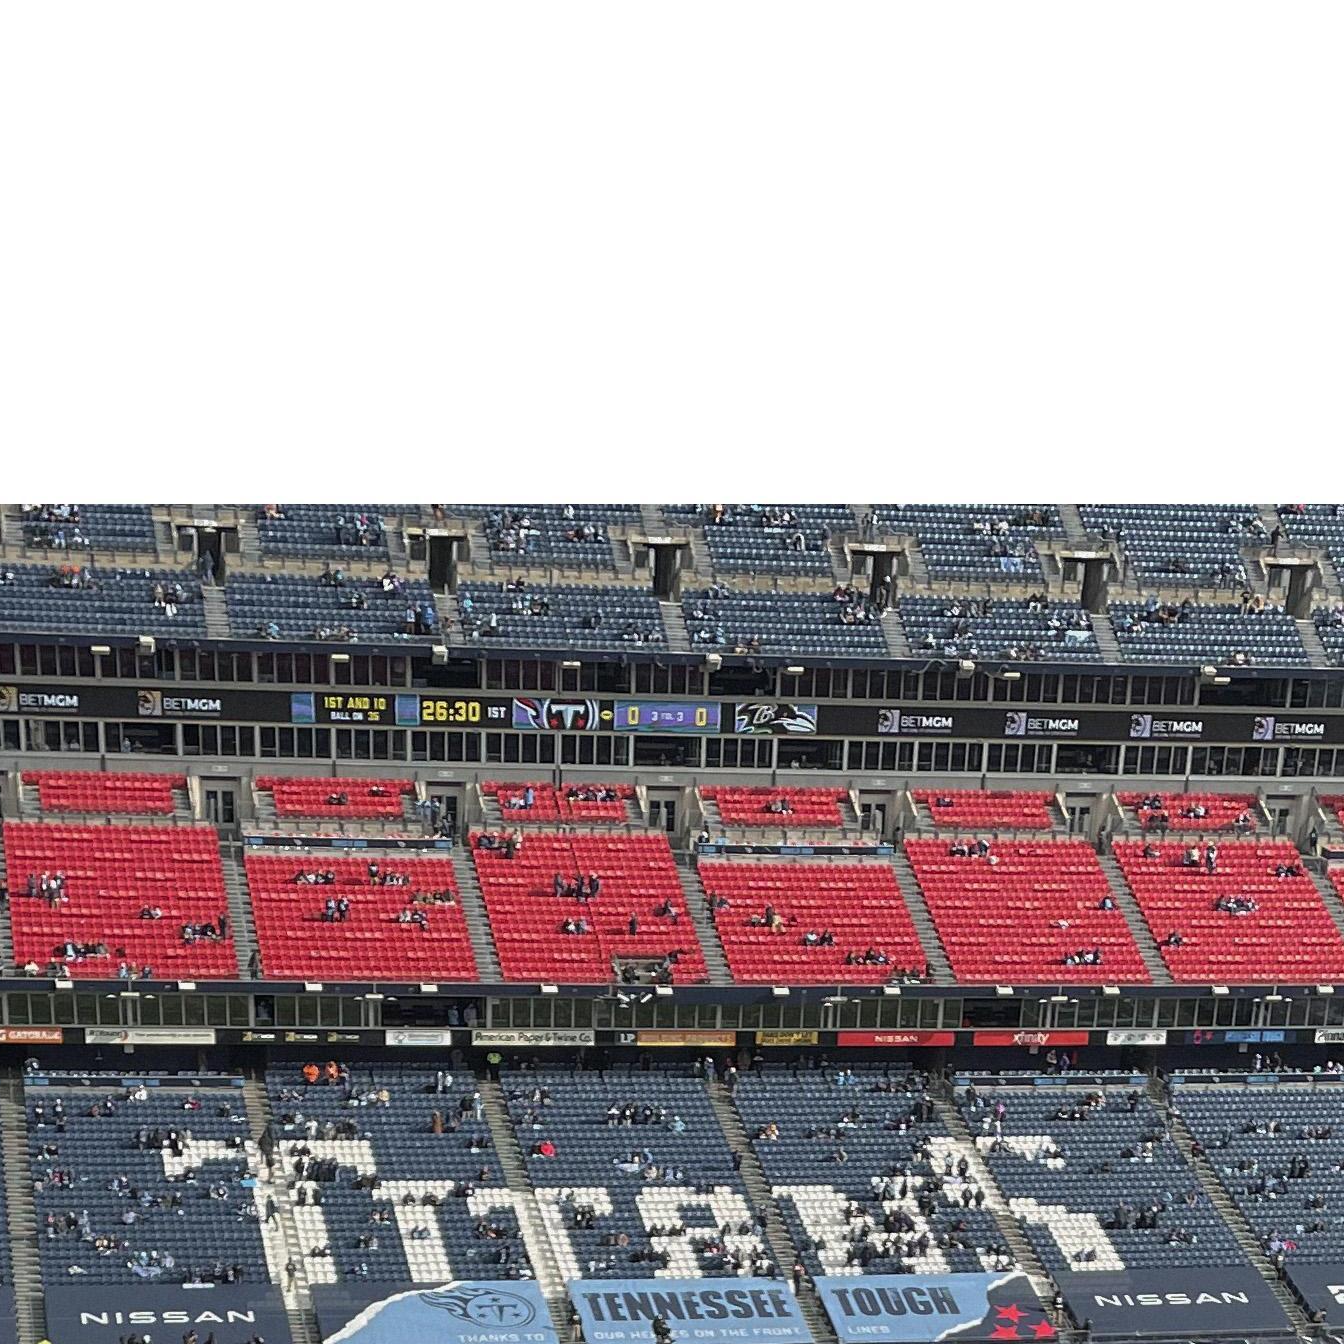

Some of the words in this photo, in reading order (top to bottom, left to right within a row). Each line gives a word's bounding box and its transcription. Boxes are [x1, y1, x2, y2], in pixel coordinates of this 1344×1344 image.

[19, 693, 79, 708] BETMGM
[163, 697, 221, 711] BETMGM
[324, 696, 343, 708] 1ST
[374, 698, 386, 710] 10
[422, 700, 481, 722] 26:30
[488, 707, 506, 718] 1ST
[627, 706, 639, 725] 0
[695, 707, 707, 726] 0
[901, 715, 953, 729] BETMGM
[1028, 716, 1079, 731] BETMGM
[1153, 720, 1203, 733] BETMGM
[1276, 722, 1324, 735] BETMGM
[475, 1032, 515, 1042] American
[518, 1032, 543, 1044] Paper
[553, 1032, 577, 1042] Twine
[621, 1033, 635, 1043] LP
[582, 1289, 792, 1321] TENNESSEE
[831, 1287, 961, 1317] TOUGH
[1094, 1291, 1249, 1307] NISSAN
[80, 1310, 256, 1325] NISSAN
[457, 1334, 518, 1344] THANKS
[525, 1333, 545, 1343] TO
[594, 1330, 625, 1340] OUR
[629, 1329, 690, 1340] HEES
[694, 1329, 715, 1339] ON
[722, 1327, 749, 1337] THE
[752, 1326, 802, 1336] FRONT
[847, 1325, 890, 1335] LINES
